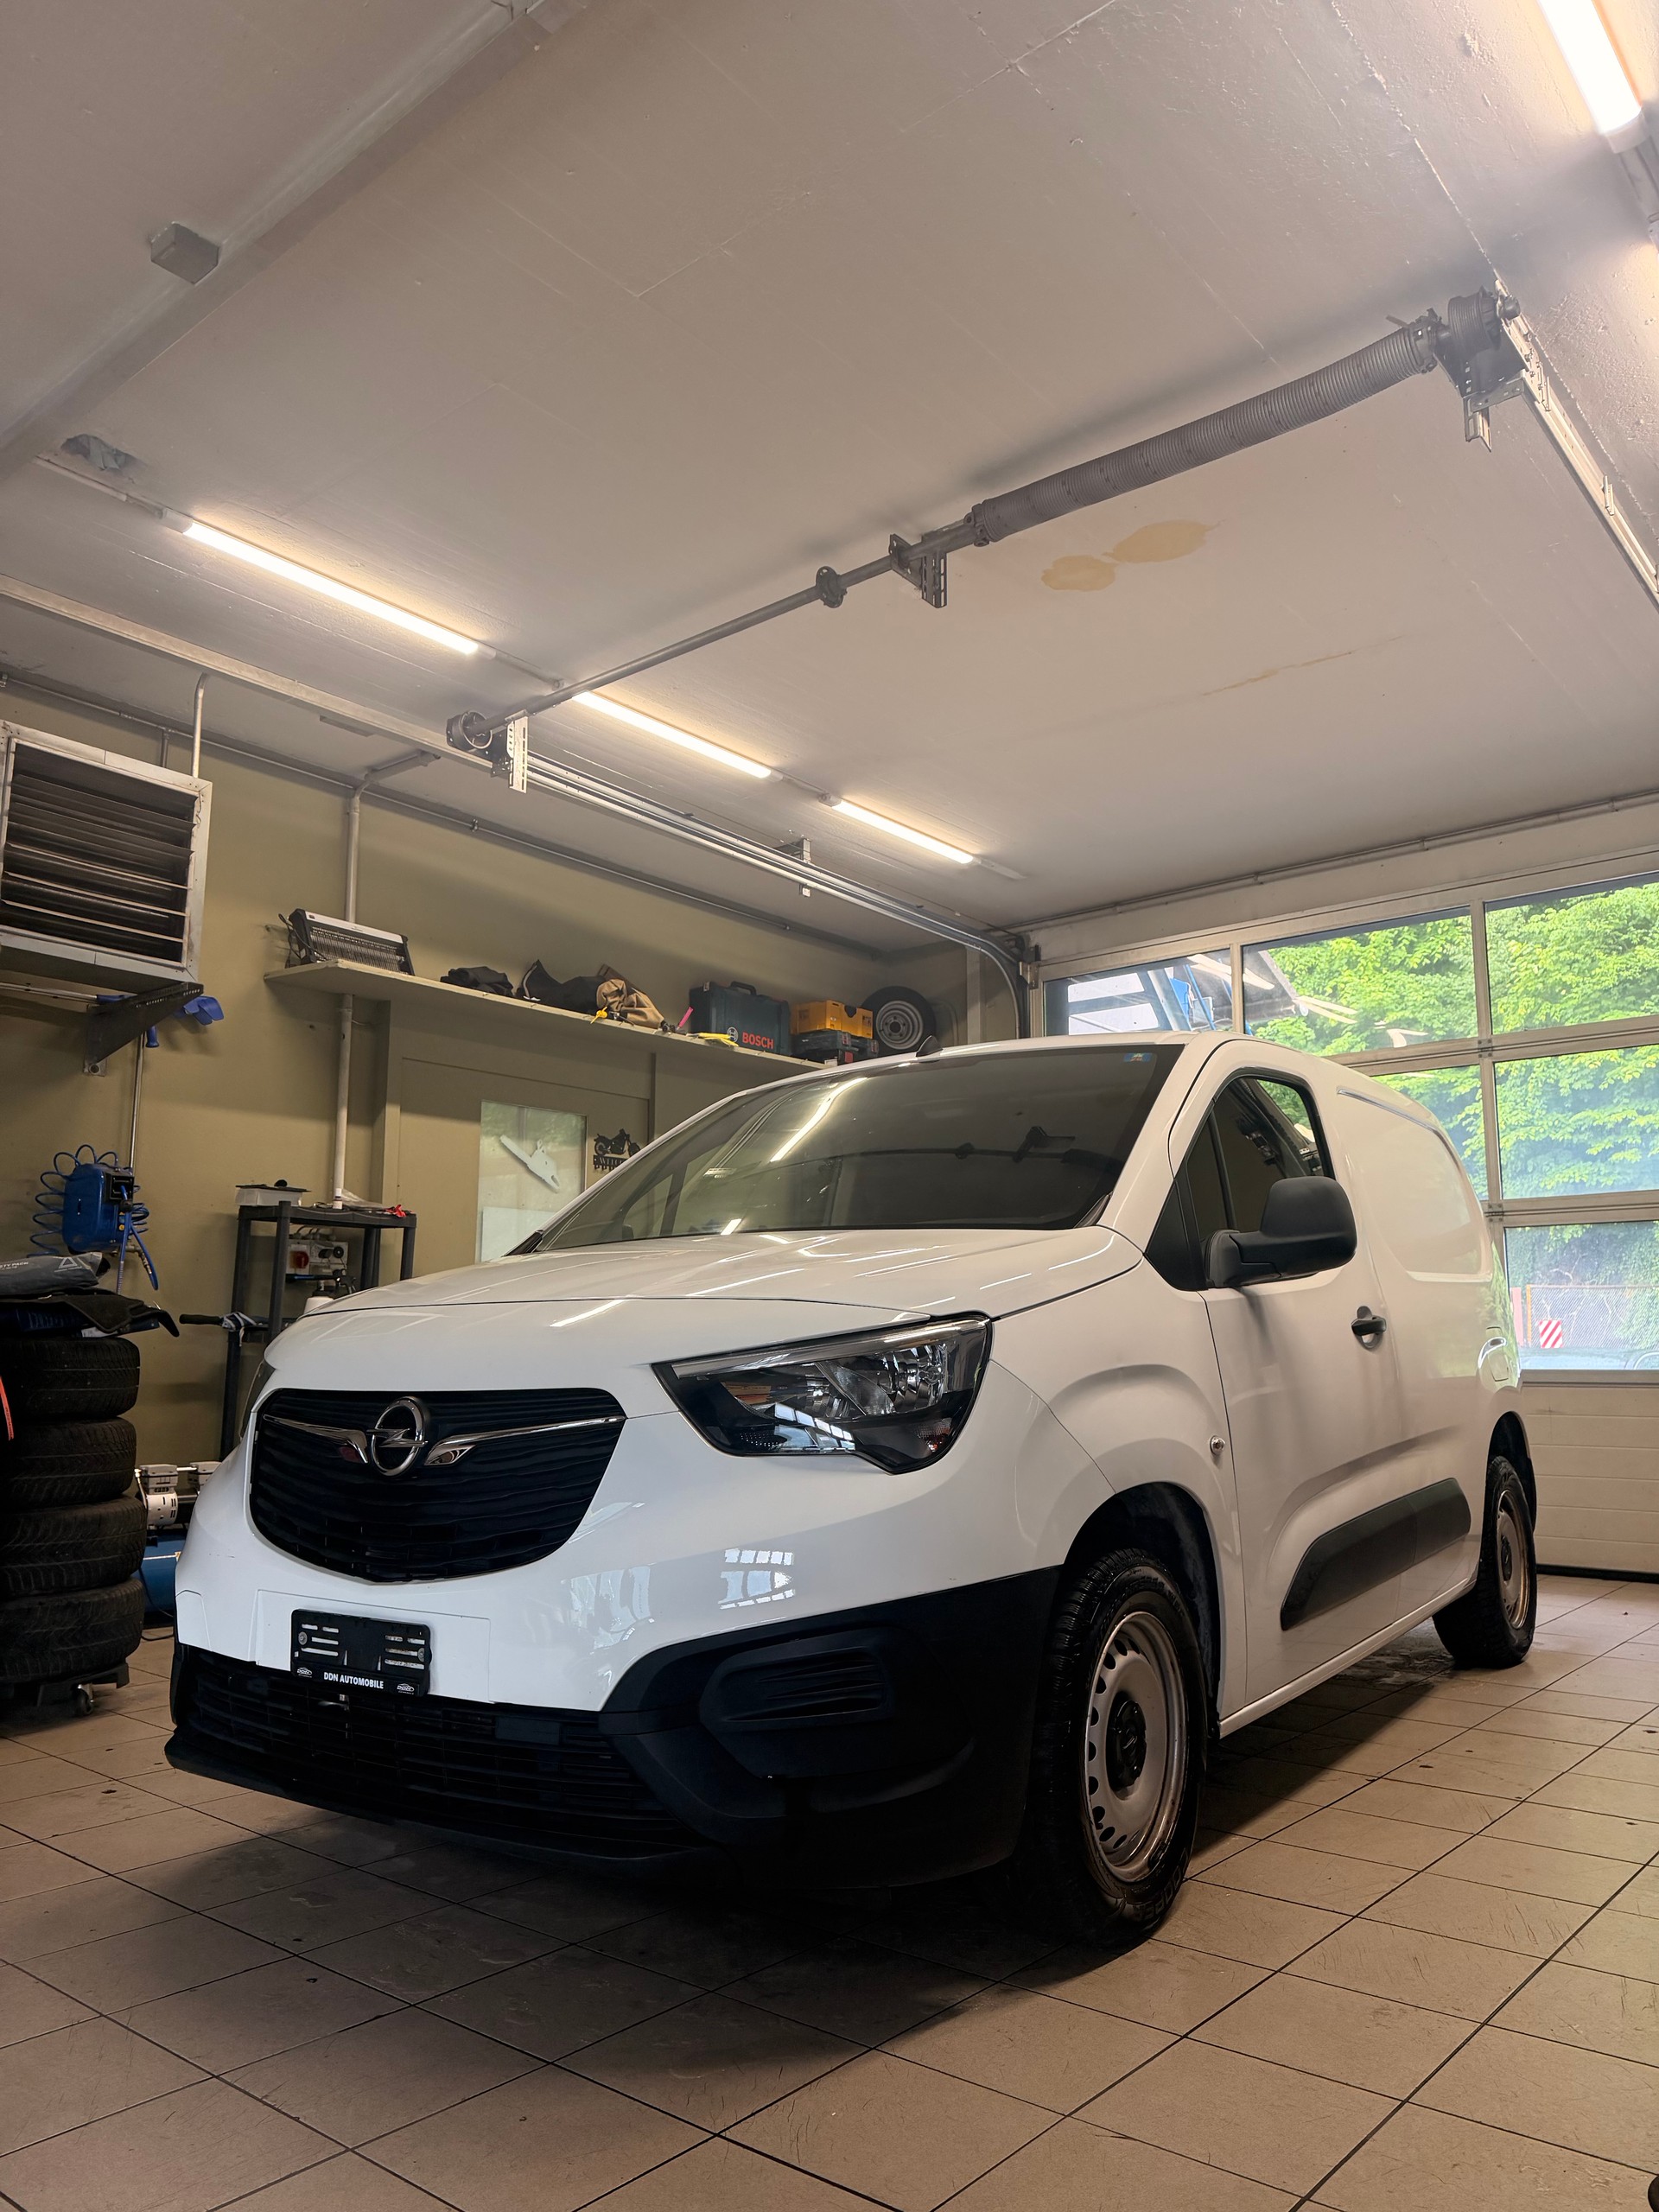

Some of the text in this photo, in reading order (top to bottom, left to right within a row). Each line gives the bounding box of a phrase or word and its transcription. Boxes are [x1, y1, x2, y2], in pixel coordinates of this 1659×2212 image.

[742, 1032, 774, 1050] BOSCH
[324, 1672, 384, 1689] DDN AUTOMOBILE
[1133, 1846, 1190, 1921] COOPER
